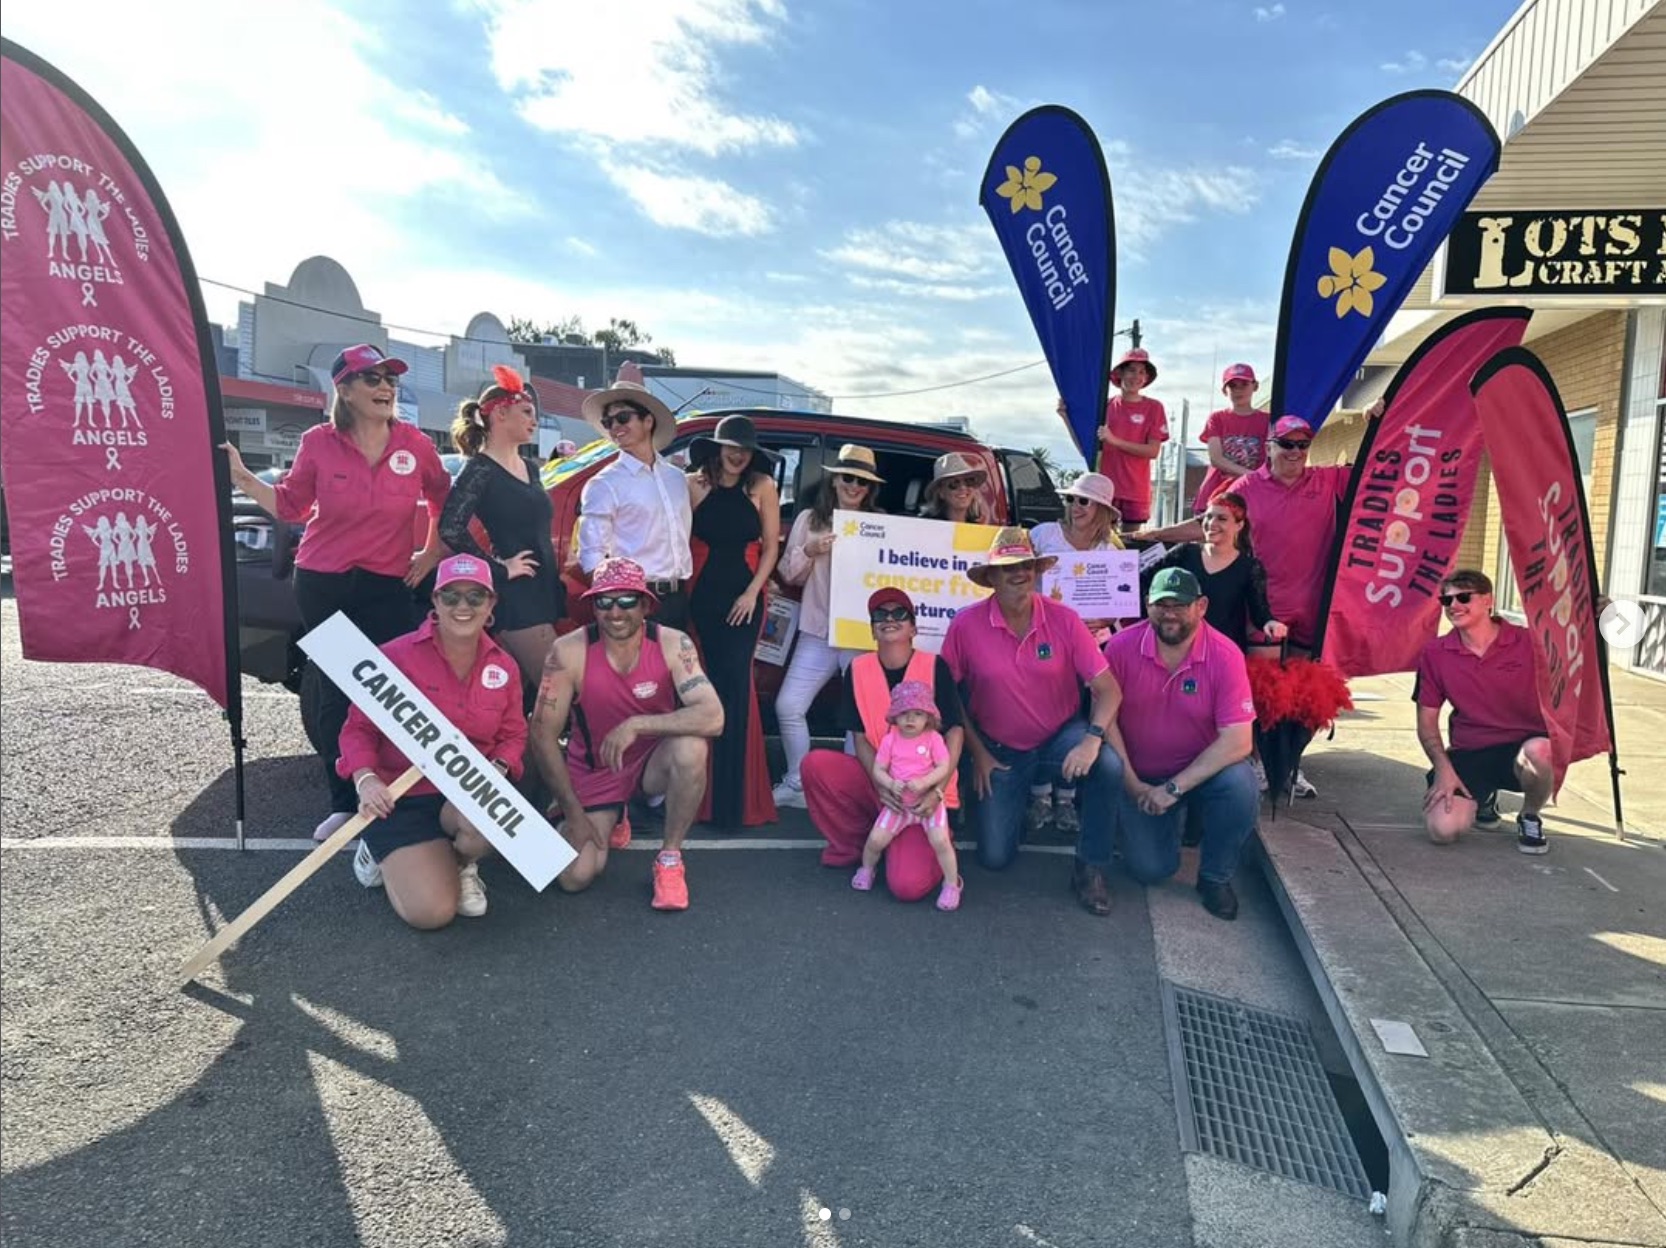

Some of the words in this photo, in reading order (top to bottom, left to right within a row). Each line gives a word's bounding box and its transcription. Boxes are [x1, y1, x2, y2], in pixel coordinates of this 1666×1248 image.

[1, 171, 23, 242] TRADIES
[18, 154, 94, 177] SUPPORT
[98, 174, 126, 204] THE
[1356, 140, 1434, 238] Cancer
[1384, 147, 1472, 250] Council
[49, 261, 124, 285] ANGELS
[1026, 221, 1075, 312] Council
[1045, 204, 1090, 289] Cancer
[1473, 215, 1643, 289] LOTS
[1538, 260, 1648, 285] CRAFT
[26, 346, 51, 414] TRADIES
[47, 324, 123, 349] SUPPORT
[127, 337, 157, 366] THE
[152, 365, 175, 420] LADIES
[72, 429, 148, 447] ANGELS
[50, 514, 74, 582] TRADIES
[69, 488, 146, 516] SUPPORT
[147, 496, 173, 523] THE
[167, 522, 189, 574] LADIES
[860, 521, 885, 531] Cancer
[860, 529, 886, 539] Council
[1347, 449, 1403, 569] TRADIES
[1366, 424, 1441, 608] Support
[1428, 447, 1463, 541] LADIES
[96, 588, 166, 609] ANGELS
[863, 572, 944, 594] cancer
[878, 549, 884, 563] I
[888, 548, 949, 571] believe
[952, 555, 968, 571] in
[1409, 547, 1450, 600] THE
[1538, 481, 1584, 698] Suppor
[914, 602, 956, 619] ture
[352, 660, 440, 749] CANCER
[434, 742, 526, 838] COUNCIL
